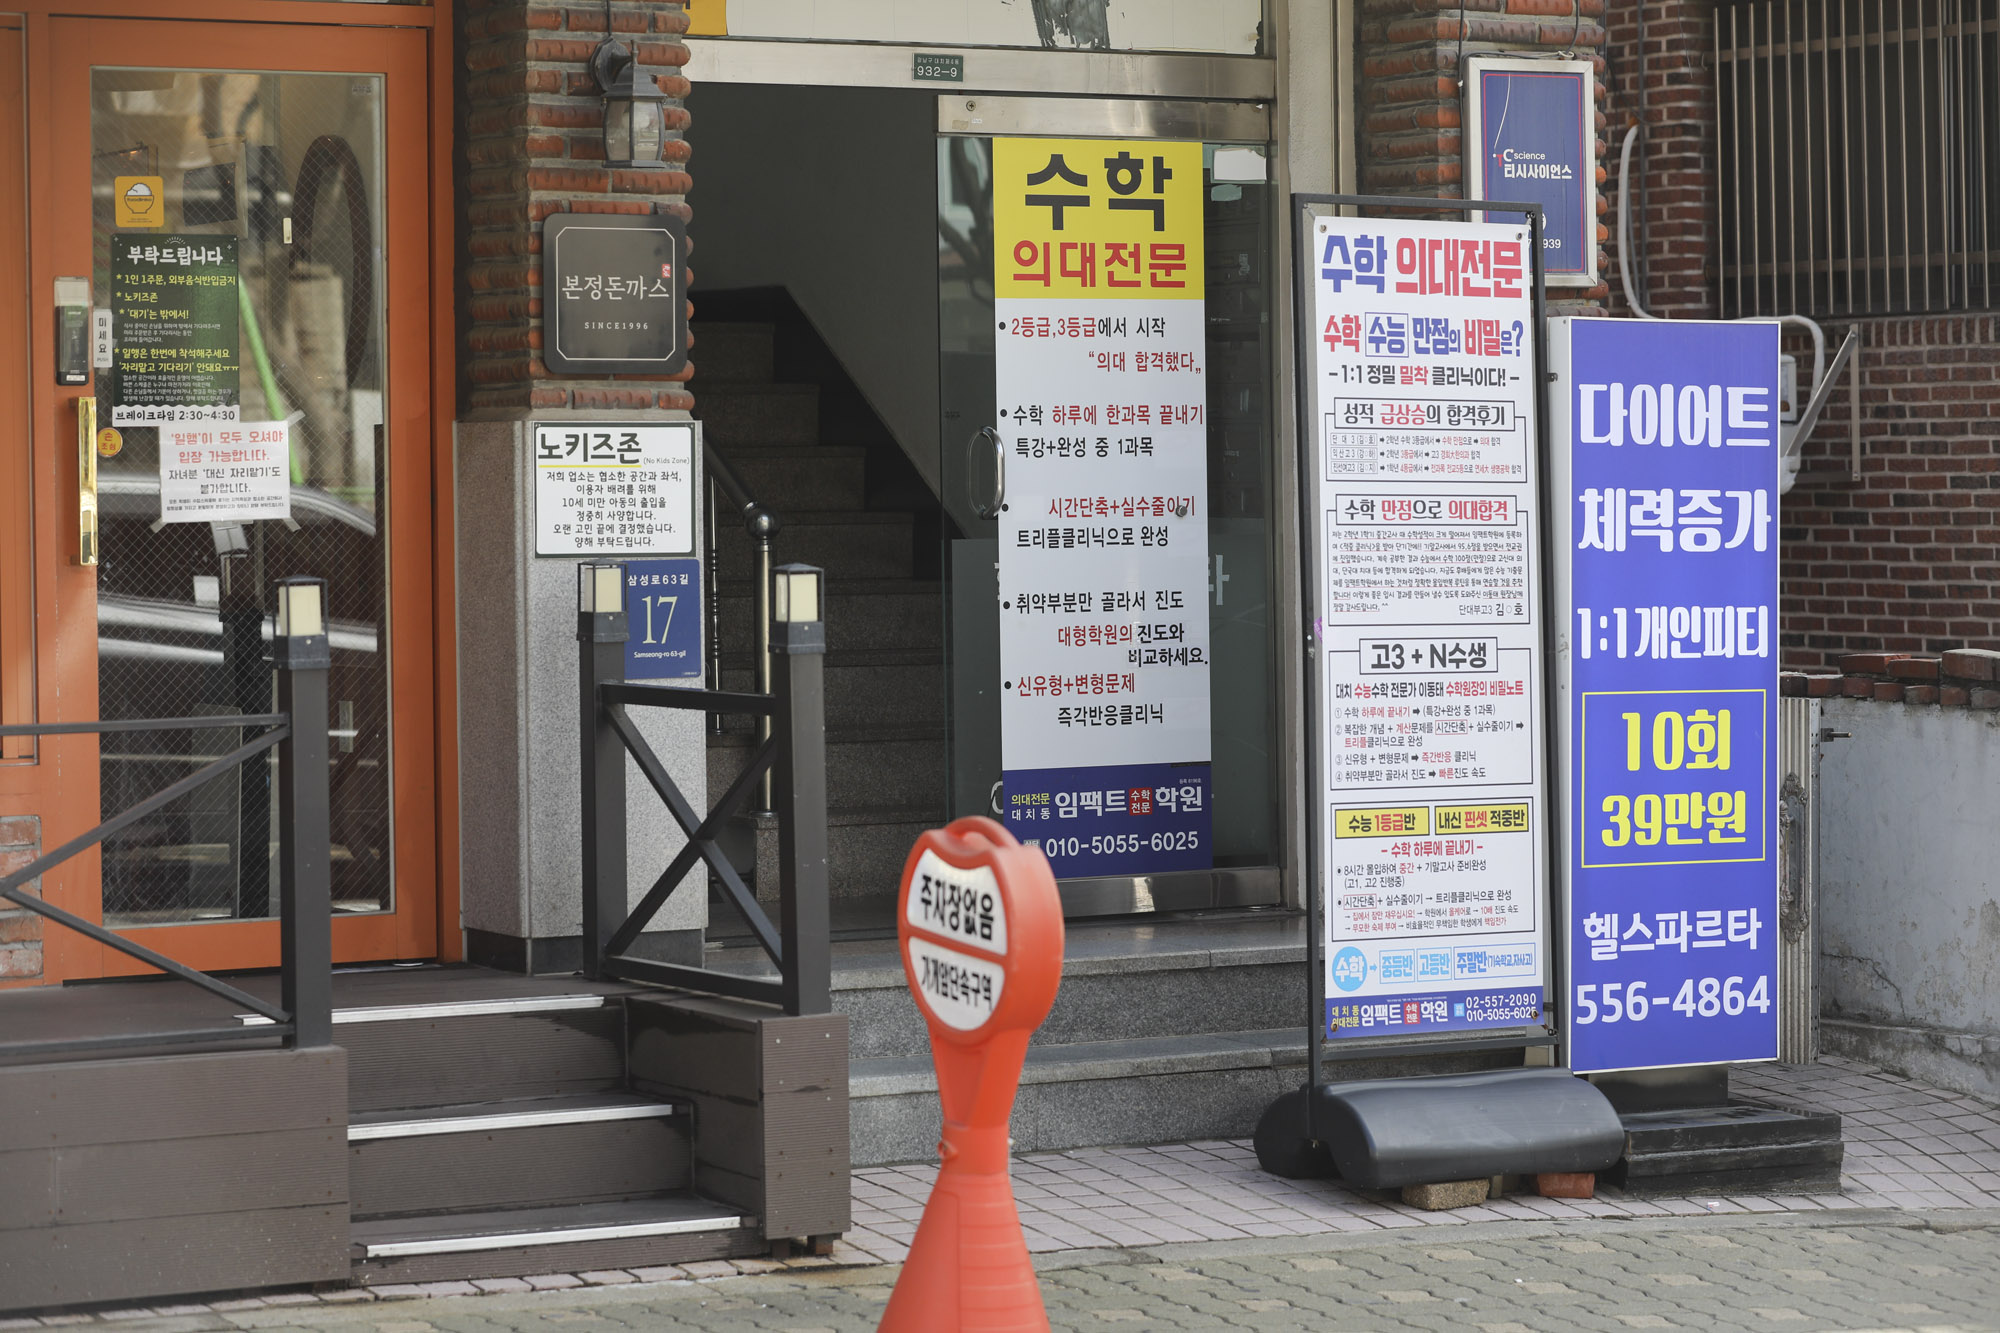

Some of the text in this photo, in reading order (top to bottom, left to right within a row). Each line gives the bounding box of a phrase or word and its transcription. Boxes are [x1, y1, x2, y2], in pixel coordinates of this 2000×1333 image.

[917, 66, 957, 77] 932-9
[1514, 152, 1545, 160] science
[1504, 163, 1572, 179] 티시사이언스
[1025, 152, 1172, 231] 수학
[128, 245, 223, 265] 부탁드립니다
[1013, 240, 1186, 288] 의대전문
[1322, 235, 1522, 298] 수학 의대전문
[124, 275, 236, 286] 1인 1주문, 외부음식반입금지
[562, 275, 669, 300] 본정돈까스
[124, 292, 158, 302] 노키즈존
[160, 310, 189, 319] 밖에서!
[99, 317, 107, 353] 미세요
[1012, 317, 1165, 338] 2등급,3등급에서 시작
[1324, 314, 1523, 357] 수학 수능 만점의 비밀은?
[123, 348, 230, 358] 일행은 한번에 착석해주세요
[1367, 365, 1395, 384] 정밀
[1400, 366, 1428, 385] 밀착
[1432, 368, 1506, 386] 클리닉이다!
[116, 410, 234, 420] 브레이크타임 2:30~4:30
[1013, 404, 1203, 426] 수학 하루에 한과목 끝내기
[1344, 403, 1505, 426] 성적 급상승의 합격후기
[1578, 382, 1770, 448] 다이어트
[104, 432, 113, 441] 손
[220, 432, 242, 443] 모두
[249, 431, 283, 443] 오셔야
[1016, 436, 1153, 458] 특강+완성 중 1과목
[179, 450, 270, 463] 입장 가능합니다.
[538, 433, 642, 464] 노키즈존
[169, 470, 198, 480] 자녀분
[547, 471, 681, 482] 저희 업소는 협소한 공간과 좌석,
[577, 485, 656, 495] 이용자 배려를 위해
[562, 498, 666, 508] 10세 미만 아동의 출입을
[1345, 499, 1507, 521] 수학 만점으로 의대합격
[577, 511, 656, 521] 정중히 사양합니다.
[1578, 488, 1772, 553] 체력증가
[553, 524, 675, 535] 오랜 고민 끝에 결정했습니다.
[1017, 525, 1169, 549] 트리플클리닉으로 완성
[575, 537, 654, 548] 양해 부탁드립니다.
[628, 574, 688, 586] 삼성로63길
[1016, 590, 1184, 614] 취약부분만 골라서 진도
[642, 595, 678, 644] 17
[1058, 623, 1184, 646] 대형학원의 진도와
[1128, 647, 1208, 667] 비교하세요.
[1371, 642, 1487, 669] 고3 N수생
[1018, 673, 1135, 697] 신유형+변형문제
[1336, 680, 1523, 699] 대치 수능수학 전문가 이동태 수학원장의 비밀노트
[1058, 703, 1163, 727] 즉각반응클리닉
[1344, 706, 1410, 718] 수학 하루에 끝내기
[1622, 709, 1731, 771] 10회
[1011, 792, 1050, 806] 의대전문
[1055, 790, 1126, 819] 임팩트
[1131, 790, 1150, 800] 수학
[1155, 786, 1202, 813] 학원
[1131, 801, 1150, 813] 전문
[1349, 809, 1525, 832] 수능 1등급반 내신 핀셋 적중반
[1601, 790, 1746, 847] 39만원
[1046, 831, 1198, 858] 010-5055-6025
[1391, 840, 1474, 858] 수학 하루에 끝내기
[921, 875, 993, 940] 주차장없음
[1583, 907, 1762, 961] 헬스파르타
[1335, 951, 1487, 982] 수학 중등반 고등반 주말반
[1406, 1004, 1417, 1014] 수학
[1466, 993, 1536, 1008] 02-557-2090
[1576, 975, 1770, 1025] 556-4864
[1361, 1004, 1402, 1026] 임팩트
[1407, 1014, 1417, 1023] 전문
[1421, 1001, 1448, 1023] 학원
